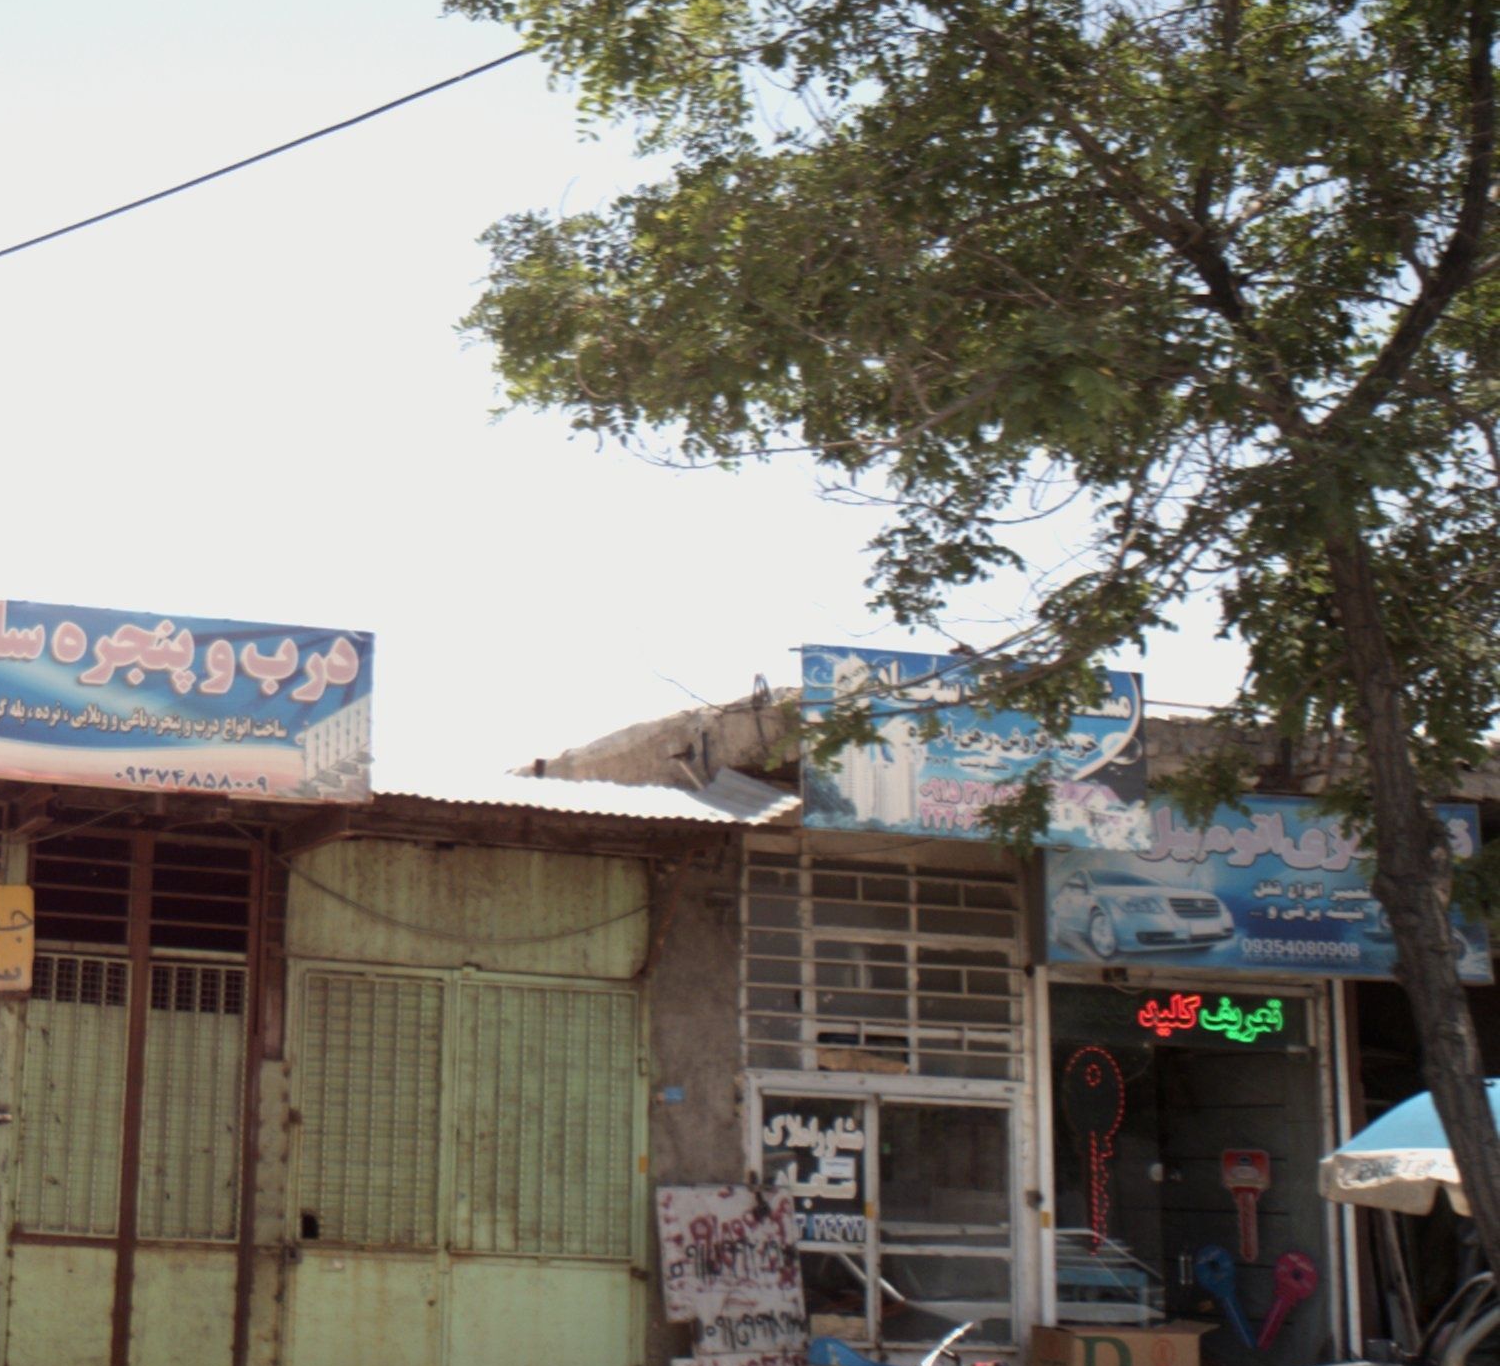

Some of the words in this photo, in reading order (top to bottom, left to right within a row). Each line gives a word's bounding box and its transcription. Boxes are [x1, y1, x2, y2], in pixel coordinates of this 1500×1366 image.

[53, 618, 196, 695] پنجره
[199, 638, 236, 695] و
[240, 636, 360, 702] درب
[194, 717, 219, 740] درب
[223, 715, 251, 742] انواع
[252, 717, 288, 738] ساخت
[1137, 993, 1201, 1037] کلید
[1200, 996, 1284, 1043] تعریف
